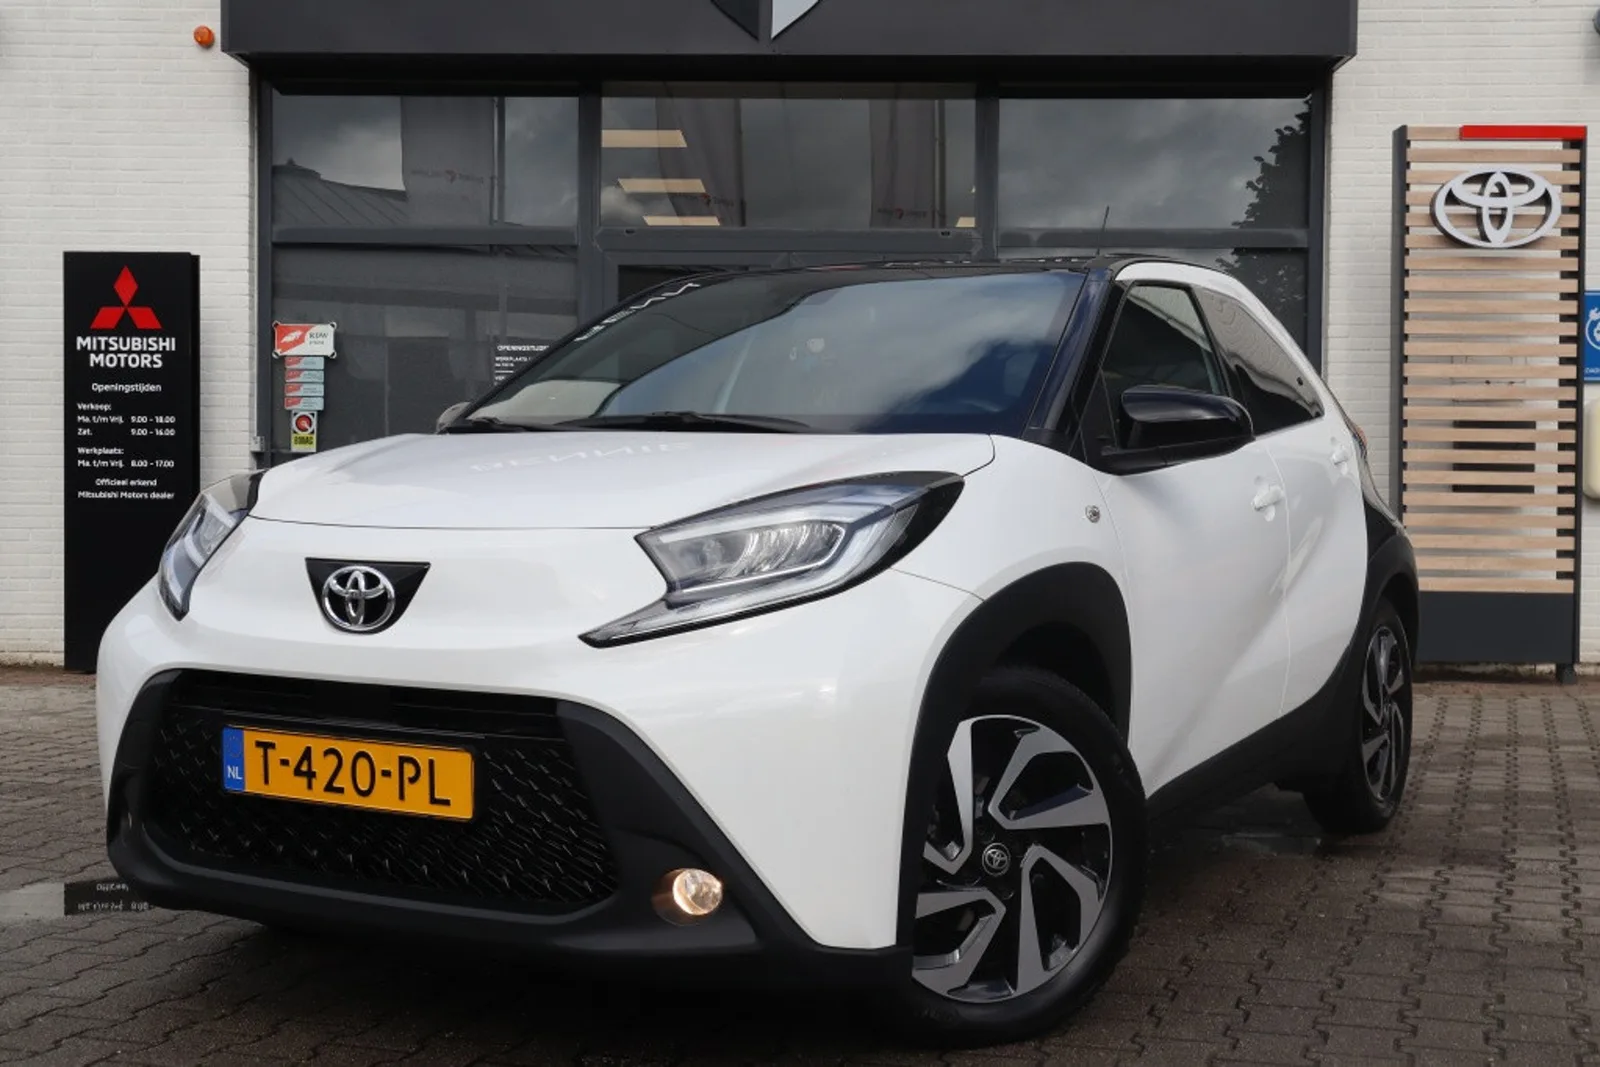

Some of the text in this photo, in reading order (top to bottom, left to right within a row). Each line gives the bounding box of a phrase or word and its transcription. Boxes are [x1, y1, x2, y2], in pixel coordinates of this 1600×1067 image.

[76, 336, 176, 351] MITSUBISHI
[89, 353, 163, 368] MOTORS
[91, 382, 162, 394] Openingstijden
[77, 402, 111, 412] Verkoop:
[92, 415, 108, 424] t/m
[131, 416, 148, 424] 9.00
[77, 428, 93, 436] Zat.
[131, 428, 148, 436] 9.00
[77, 446, 124, 456] Werkplaats:
[93, 459, 108, 468] t/m
[131, 460, 148, 468] 8.00
[155, 459, 175, 468] 17.00
[129, 478, 157, 487] erkend
[78, 491, 175, 500] Mitsubishi Motors dealer
[227, 766, 243, 780] NL
[255, 740, 451, 806] T-420-PL
